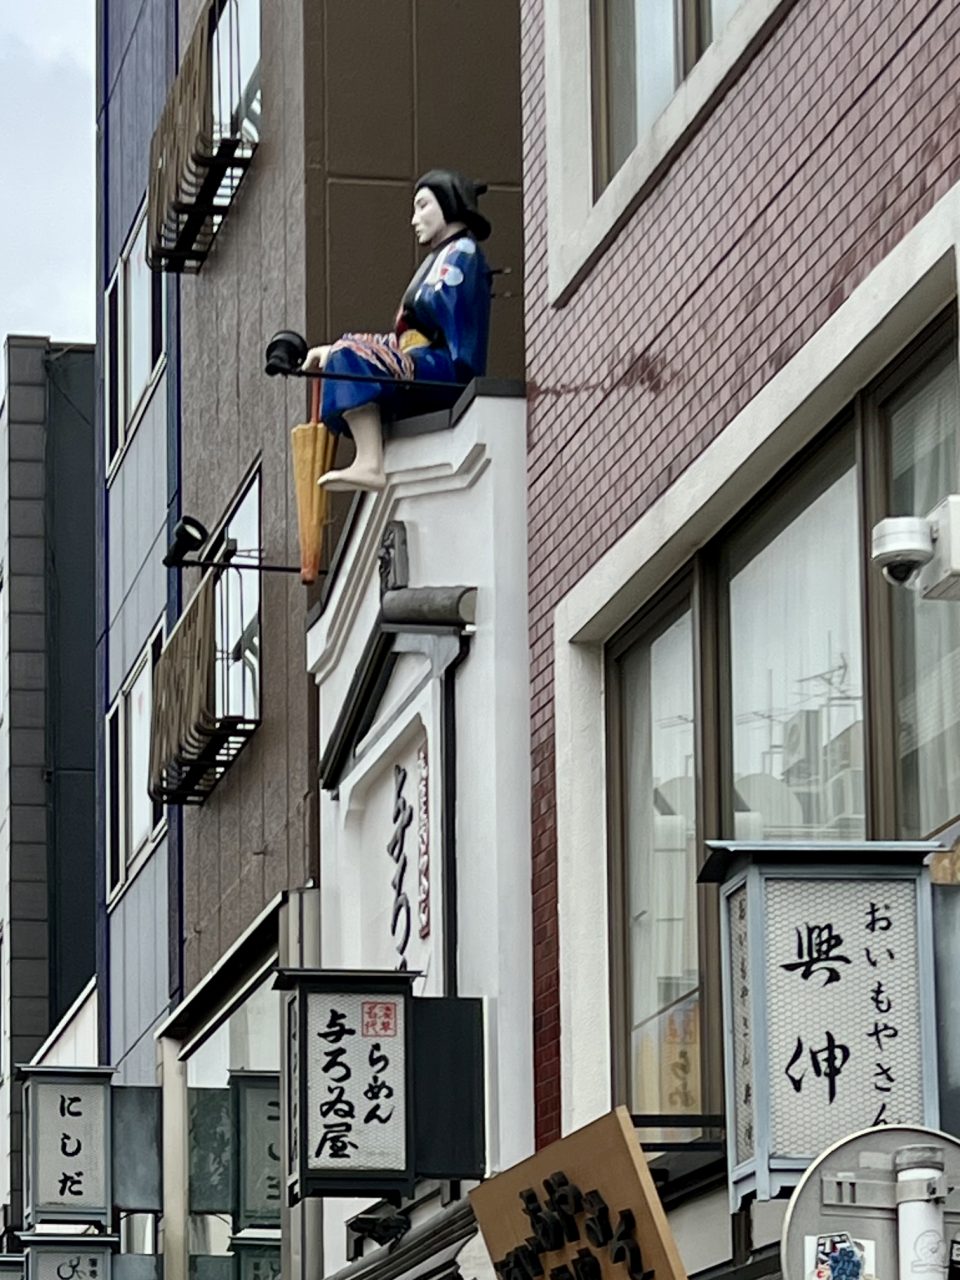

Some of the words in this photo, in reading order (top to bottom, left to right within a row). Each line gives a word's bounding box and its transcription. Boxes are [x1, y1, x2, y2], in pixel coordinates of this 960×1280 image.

[780, 921, 852, 1105] 興伸
[363, 1043, 395, 1124] らめん
[57, 1094, 84, 1196] にしだ
